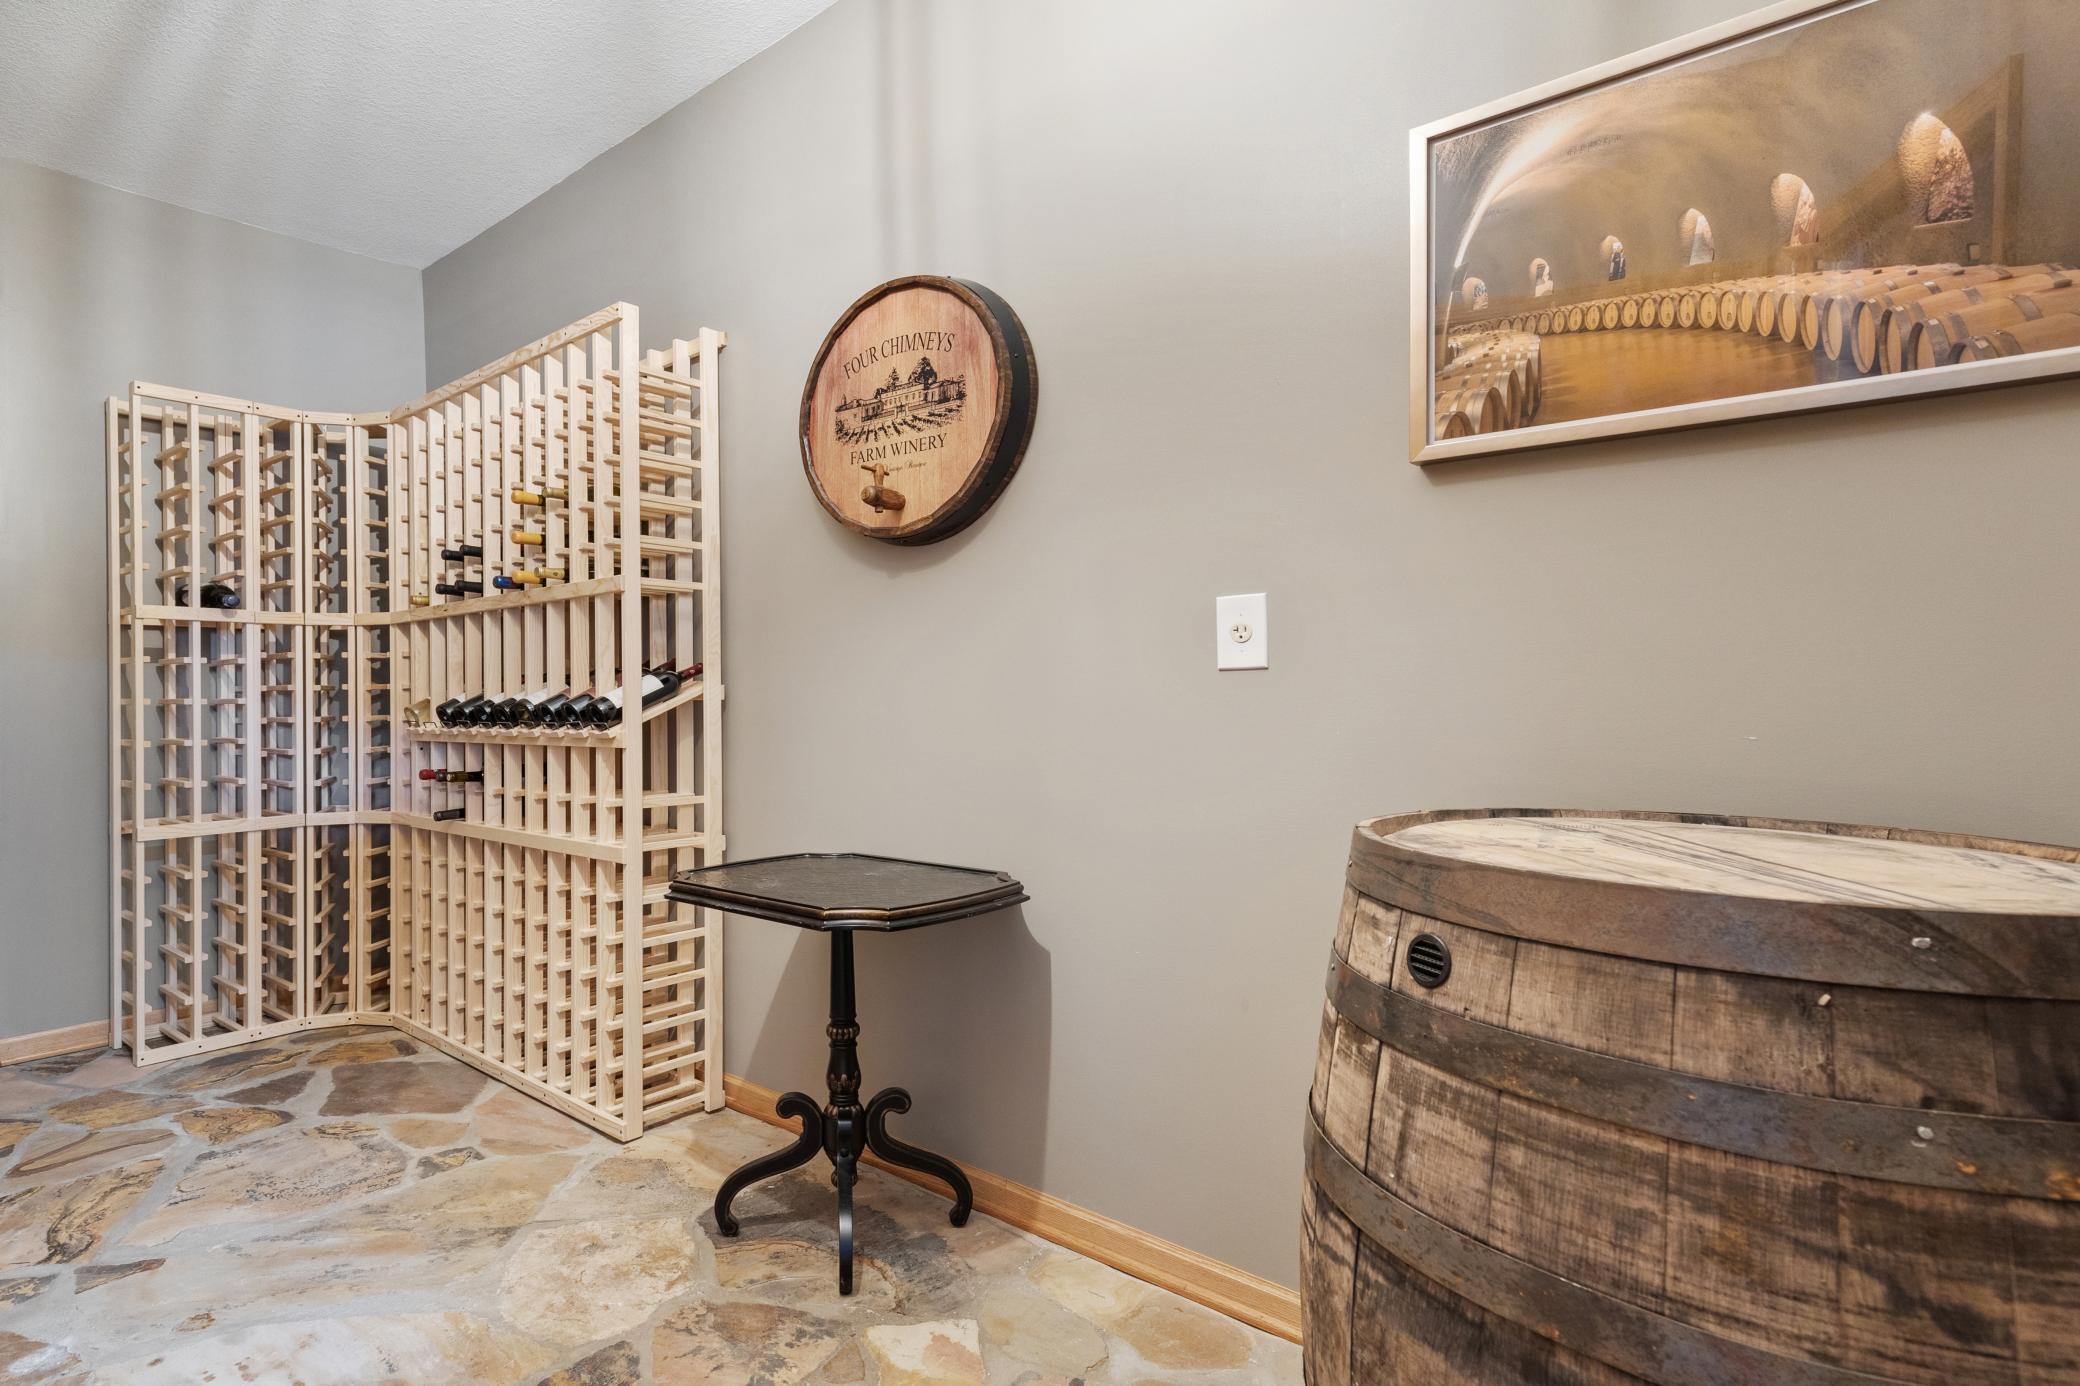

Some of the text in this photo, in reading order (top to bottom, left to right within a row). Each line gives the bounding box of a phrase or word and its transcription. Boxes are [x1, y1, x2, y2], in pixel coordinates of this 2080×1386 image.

[843, 331, 955, 379] FOUR CHIMNEYS
[850, 433, 947, 465] FARM WINERY
